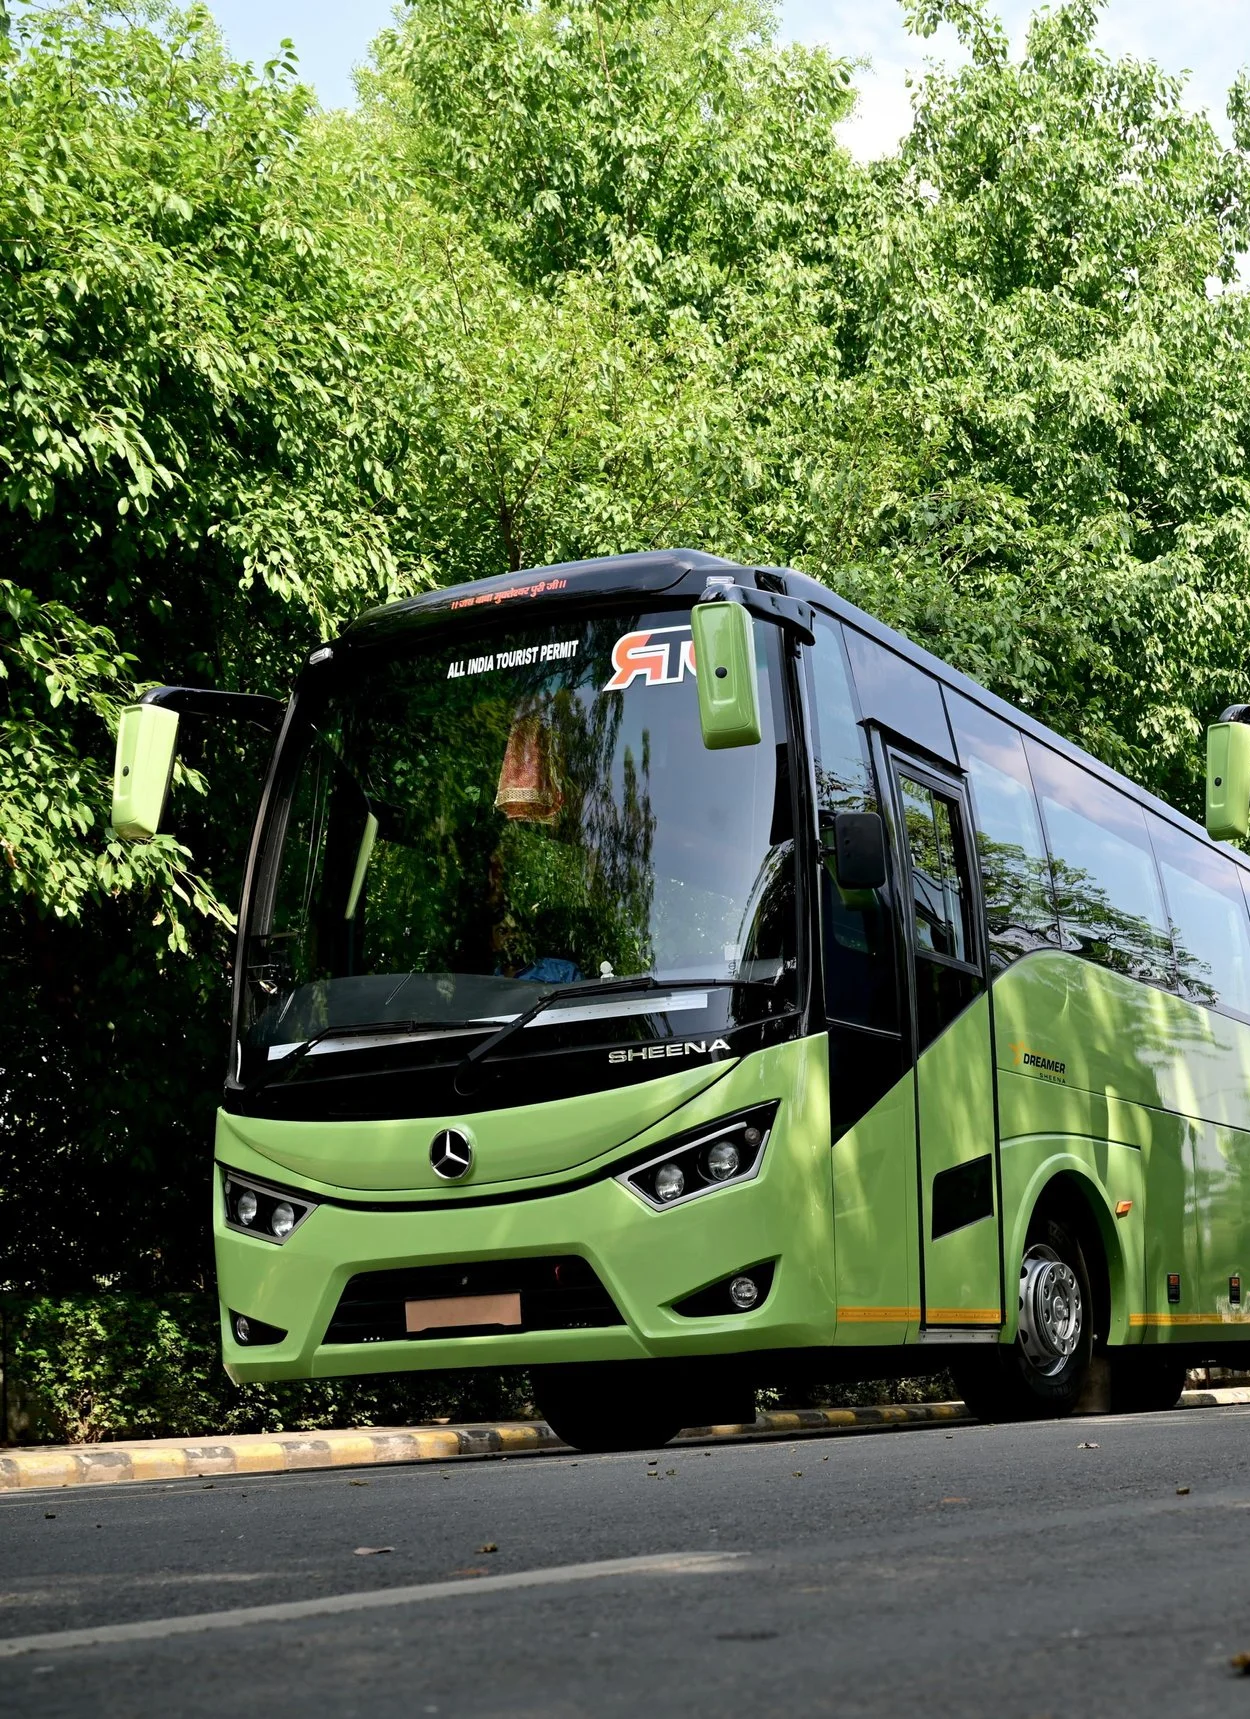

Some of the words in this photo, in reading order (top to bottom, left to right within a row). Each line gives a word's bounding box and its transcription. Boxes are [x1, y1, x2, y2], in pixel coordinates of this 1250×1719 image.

[447, 661, 466, 679] ALL
[467, 655, 494, 675] INDIA
[496, 646, 539, 670] TOURIST
[540, 640, 579, 662] PERMIT
[602, 624, 698, 692] RT
[608, 1038, 731, 1064] SHEENA
[1023, 1053, 1066, 1074] DREAMER
[1039, 1072, 1066, 1084] SHEENA
